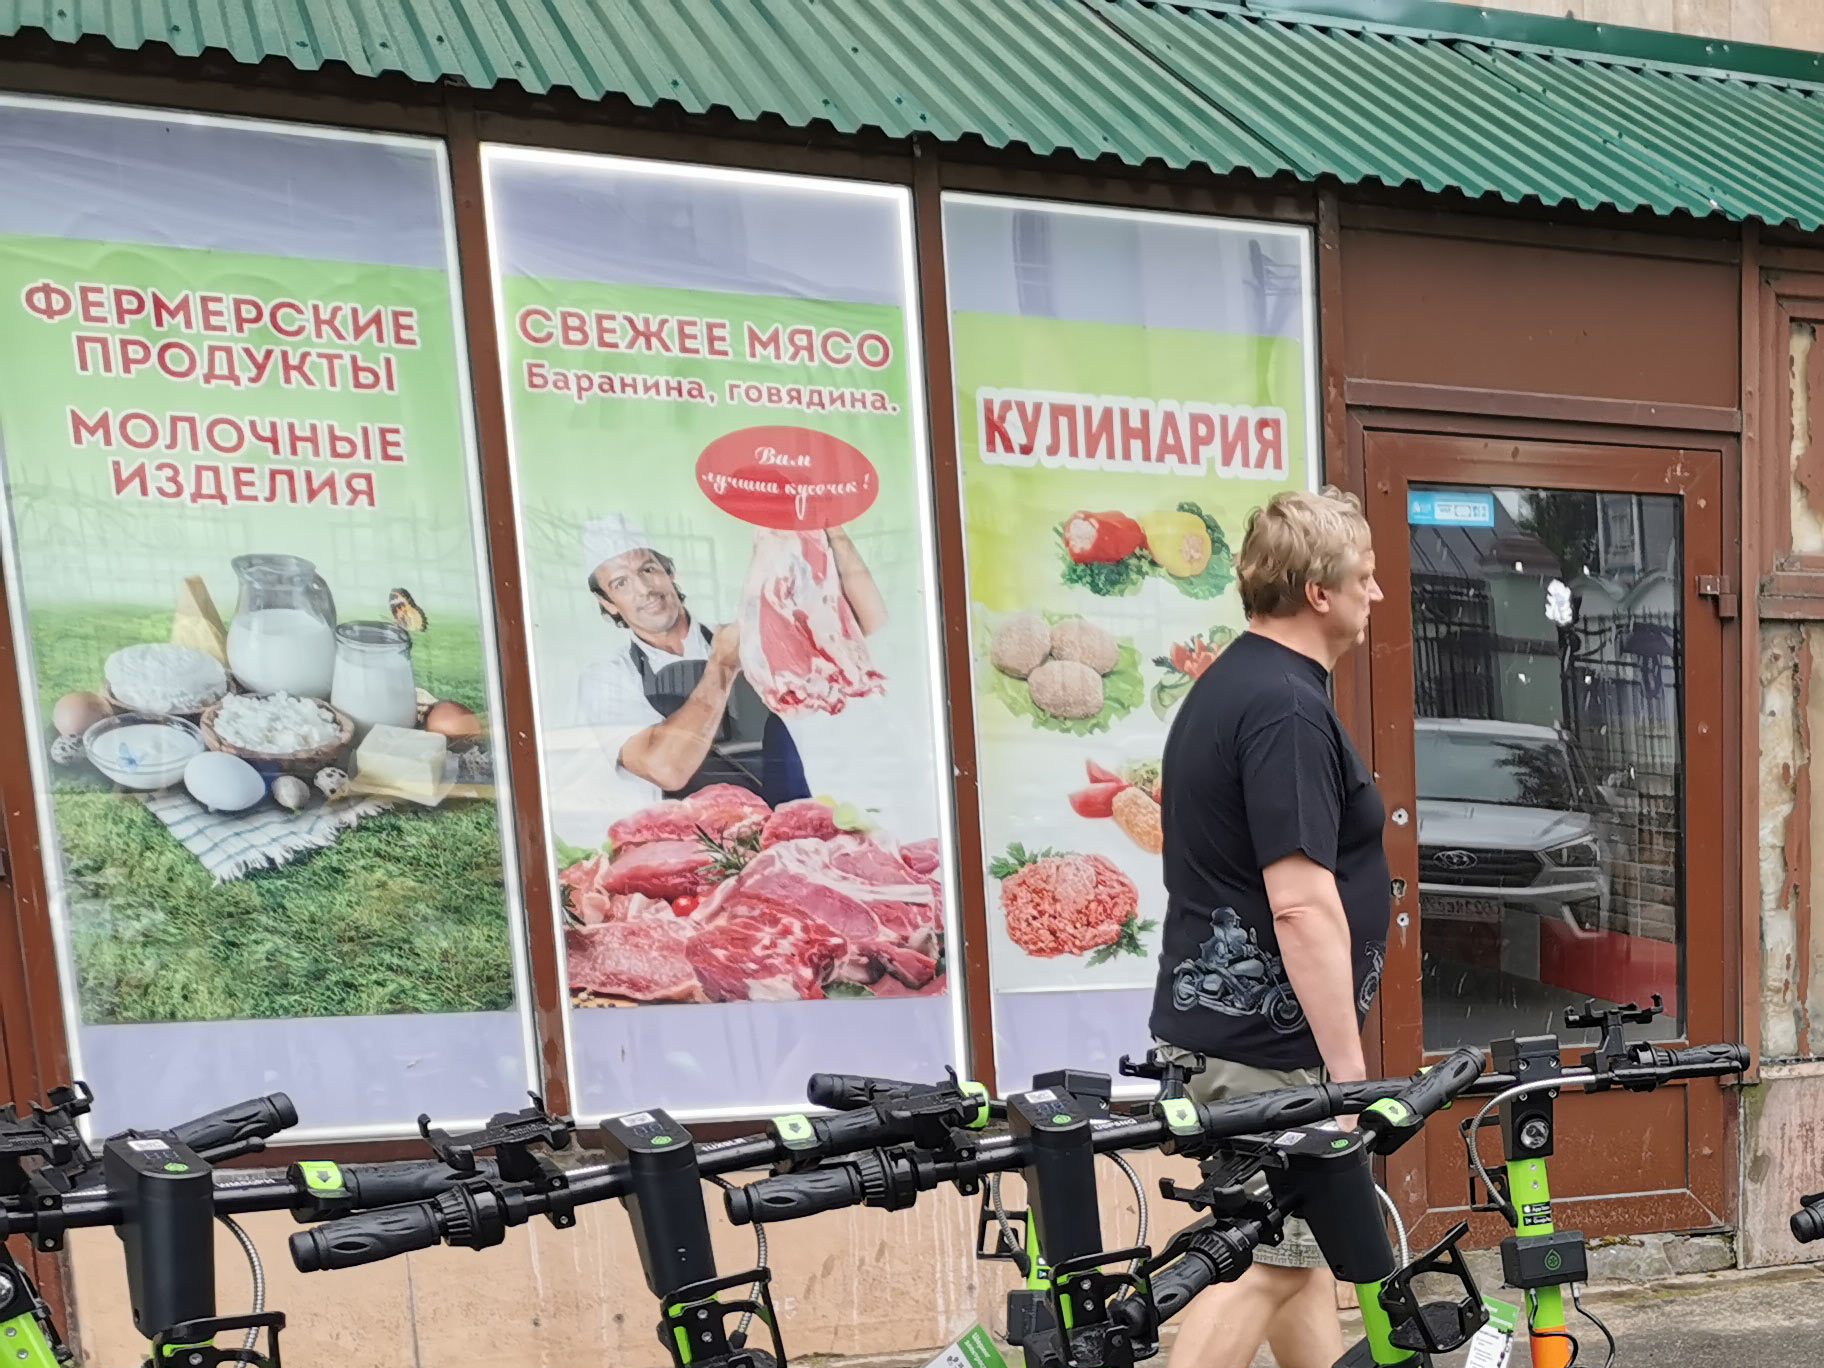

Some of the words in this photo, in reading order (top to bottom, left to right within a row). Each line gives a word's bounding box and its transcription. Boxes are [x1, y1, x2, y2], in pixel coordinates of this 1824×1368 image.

[25, 283, 418, 346] ФЕРМЕРСКИЕ
[518, 308, 729, 357] СВЕЖЕЕ
[747, 324, 891, 368] МЯСО
[74, 335, 396, 391] ПРОДУКТЫ
[526, 362, 716, 403] Баранина,
[729, 383, 898, 412] говядина.
[69, 409, 405, 462] МОЛОЧНЫЕ
[755, 447, 811, 467] Вам
[983, 398, 1283, 471] КУЛИНАРИЯ
[111, 460, 376, 507] ИЗДЕЛИЯ
[784, 482, 857, 520] кусочек
